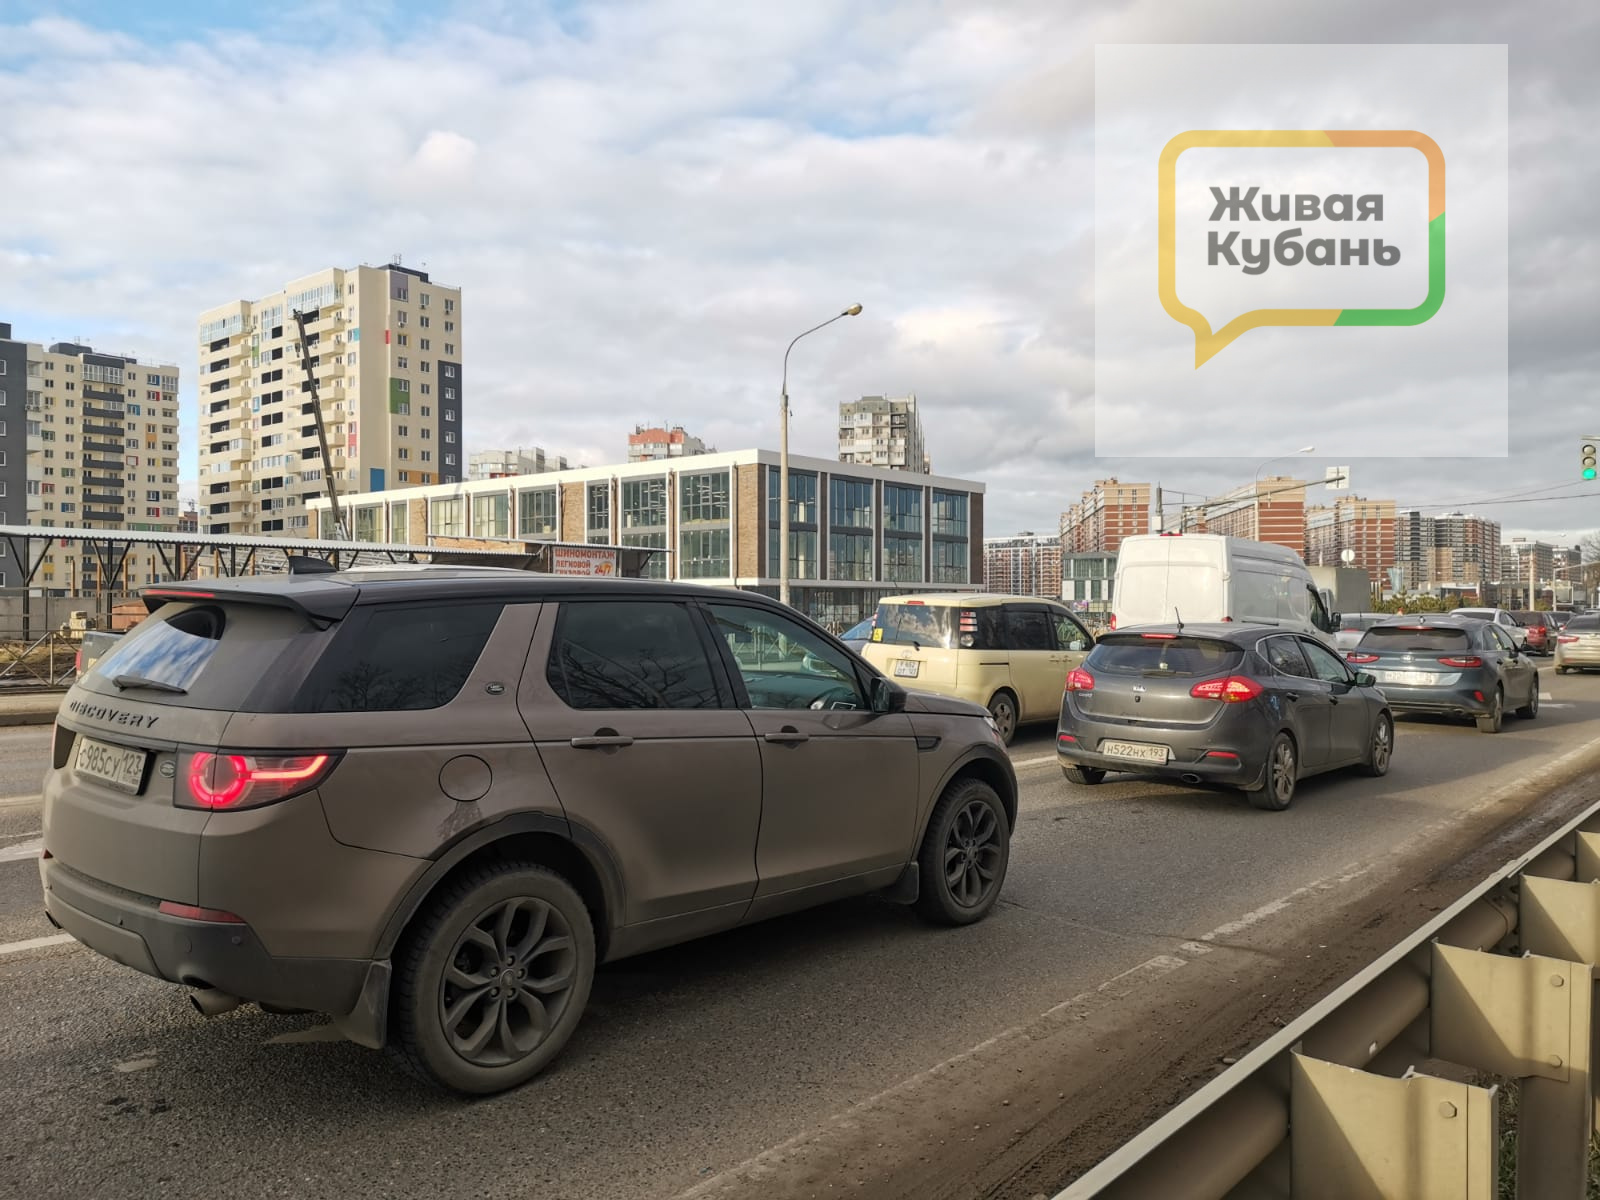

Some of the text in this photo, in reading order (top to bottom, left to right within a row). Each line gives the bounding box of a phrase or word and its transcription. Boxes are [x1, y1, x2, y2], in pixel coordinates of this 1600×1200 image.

[555, 549, 615, 559] ШИНОМОНТАЖ
[555, 560, 591, 569] ЛЕГКОВОЙ
[70, 701, 159, 728] DISCOVERY
